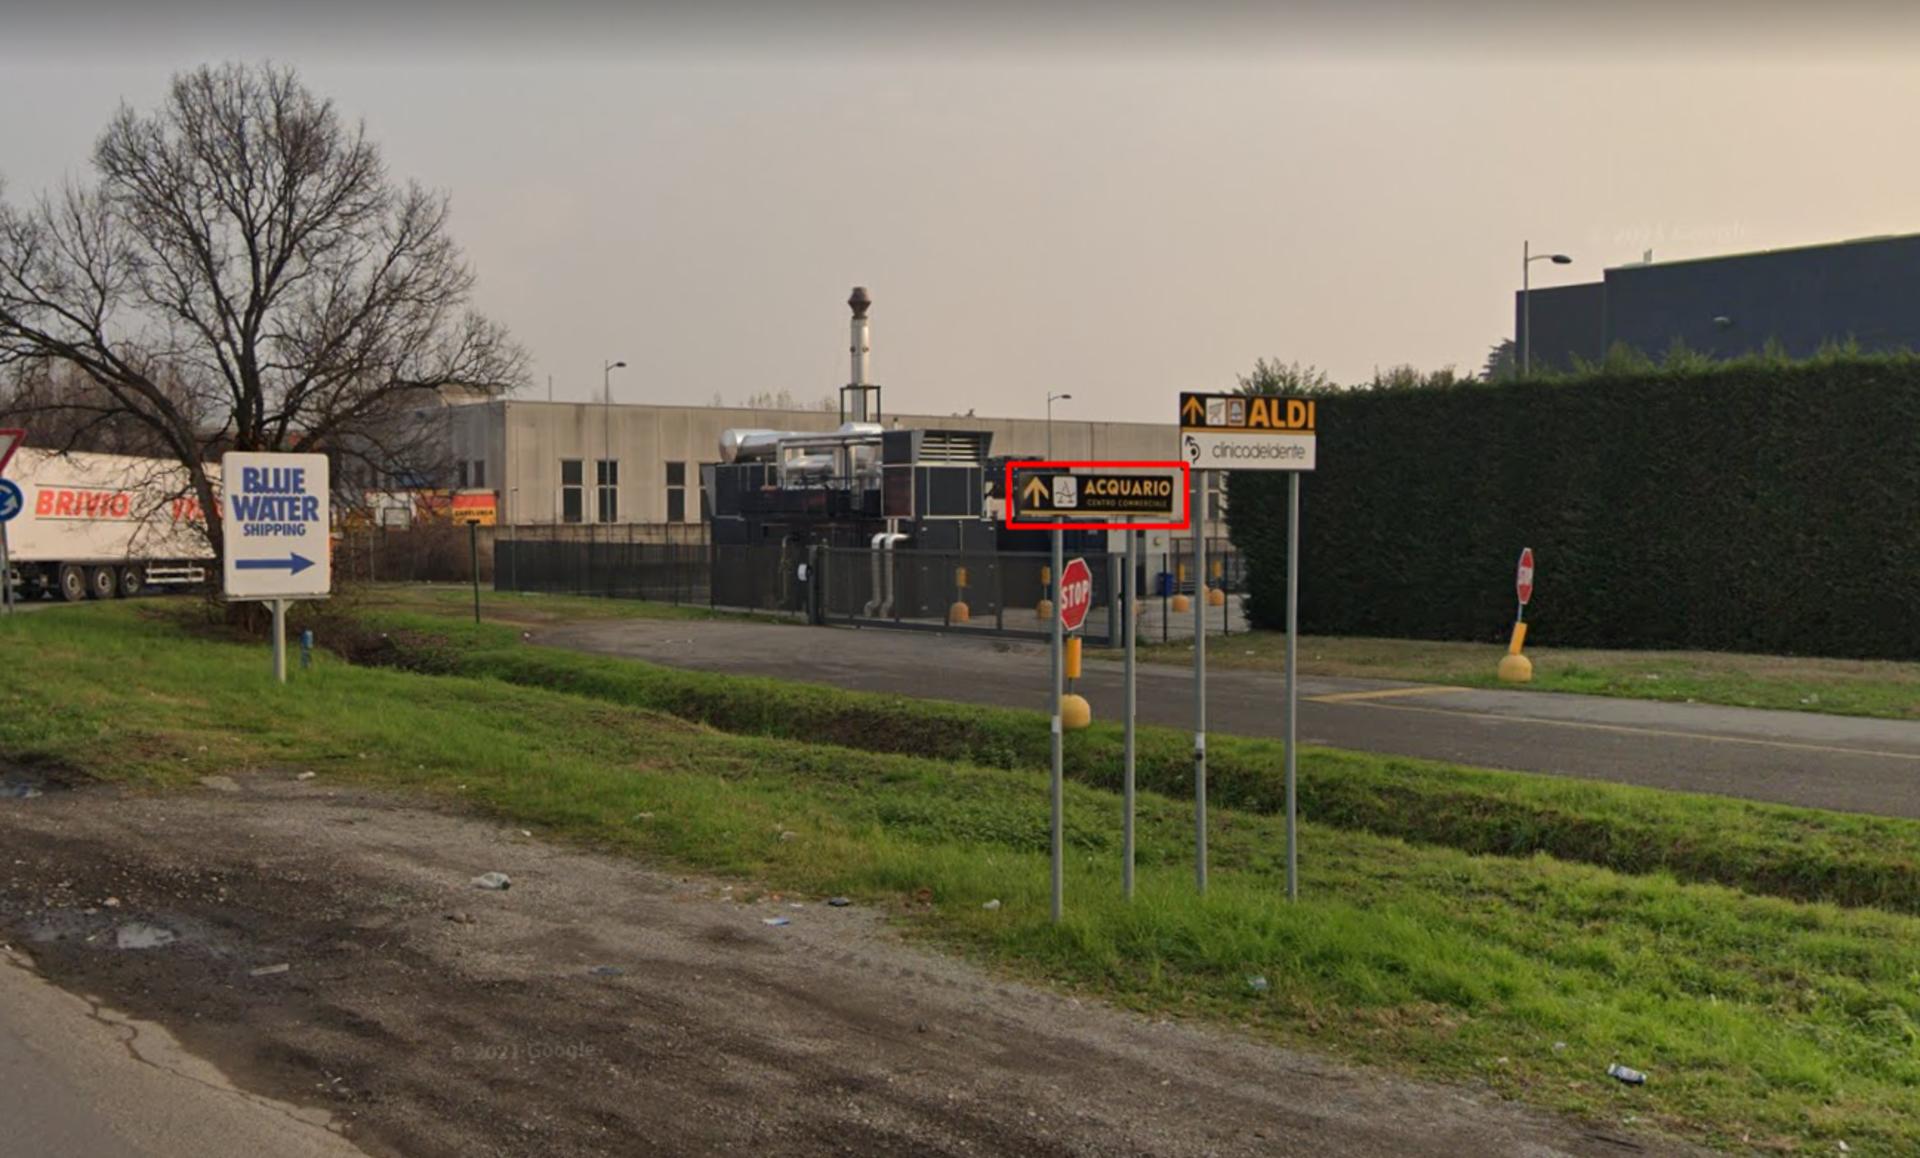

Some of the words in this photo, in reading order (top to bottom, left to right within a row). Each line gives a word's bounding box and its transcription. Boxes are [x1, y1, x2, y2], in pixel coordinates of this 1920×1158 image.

[1249, 398, 1315, 428] ALDI
[242, 467, 305, 494] BLUE
[1084, 479, 1171, 496] ACQUARIO
[35, 490, 130, 517] BRIVIO
[231, 495, 320, 521] WATER
[1087, 498, 1116, 506] CENTRO
[243, 523, 306, 536] SHIPPING
[1061, 580, 1089, 610] STOP
